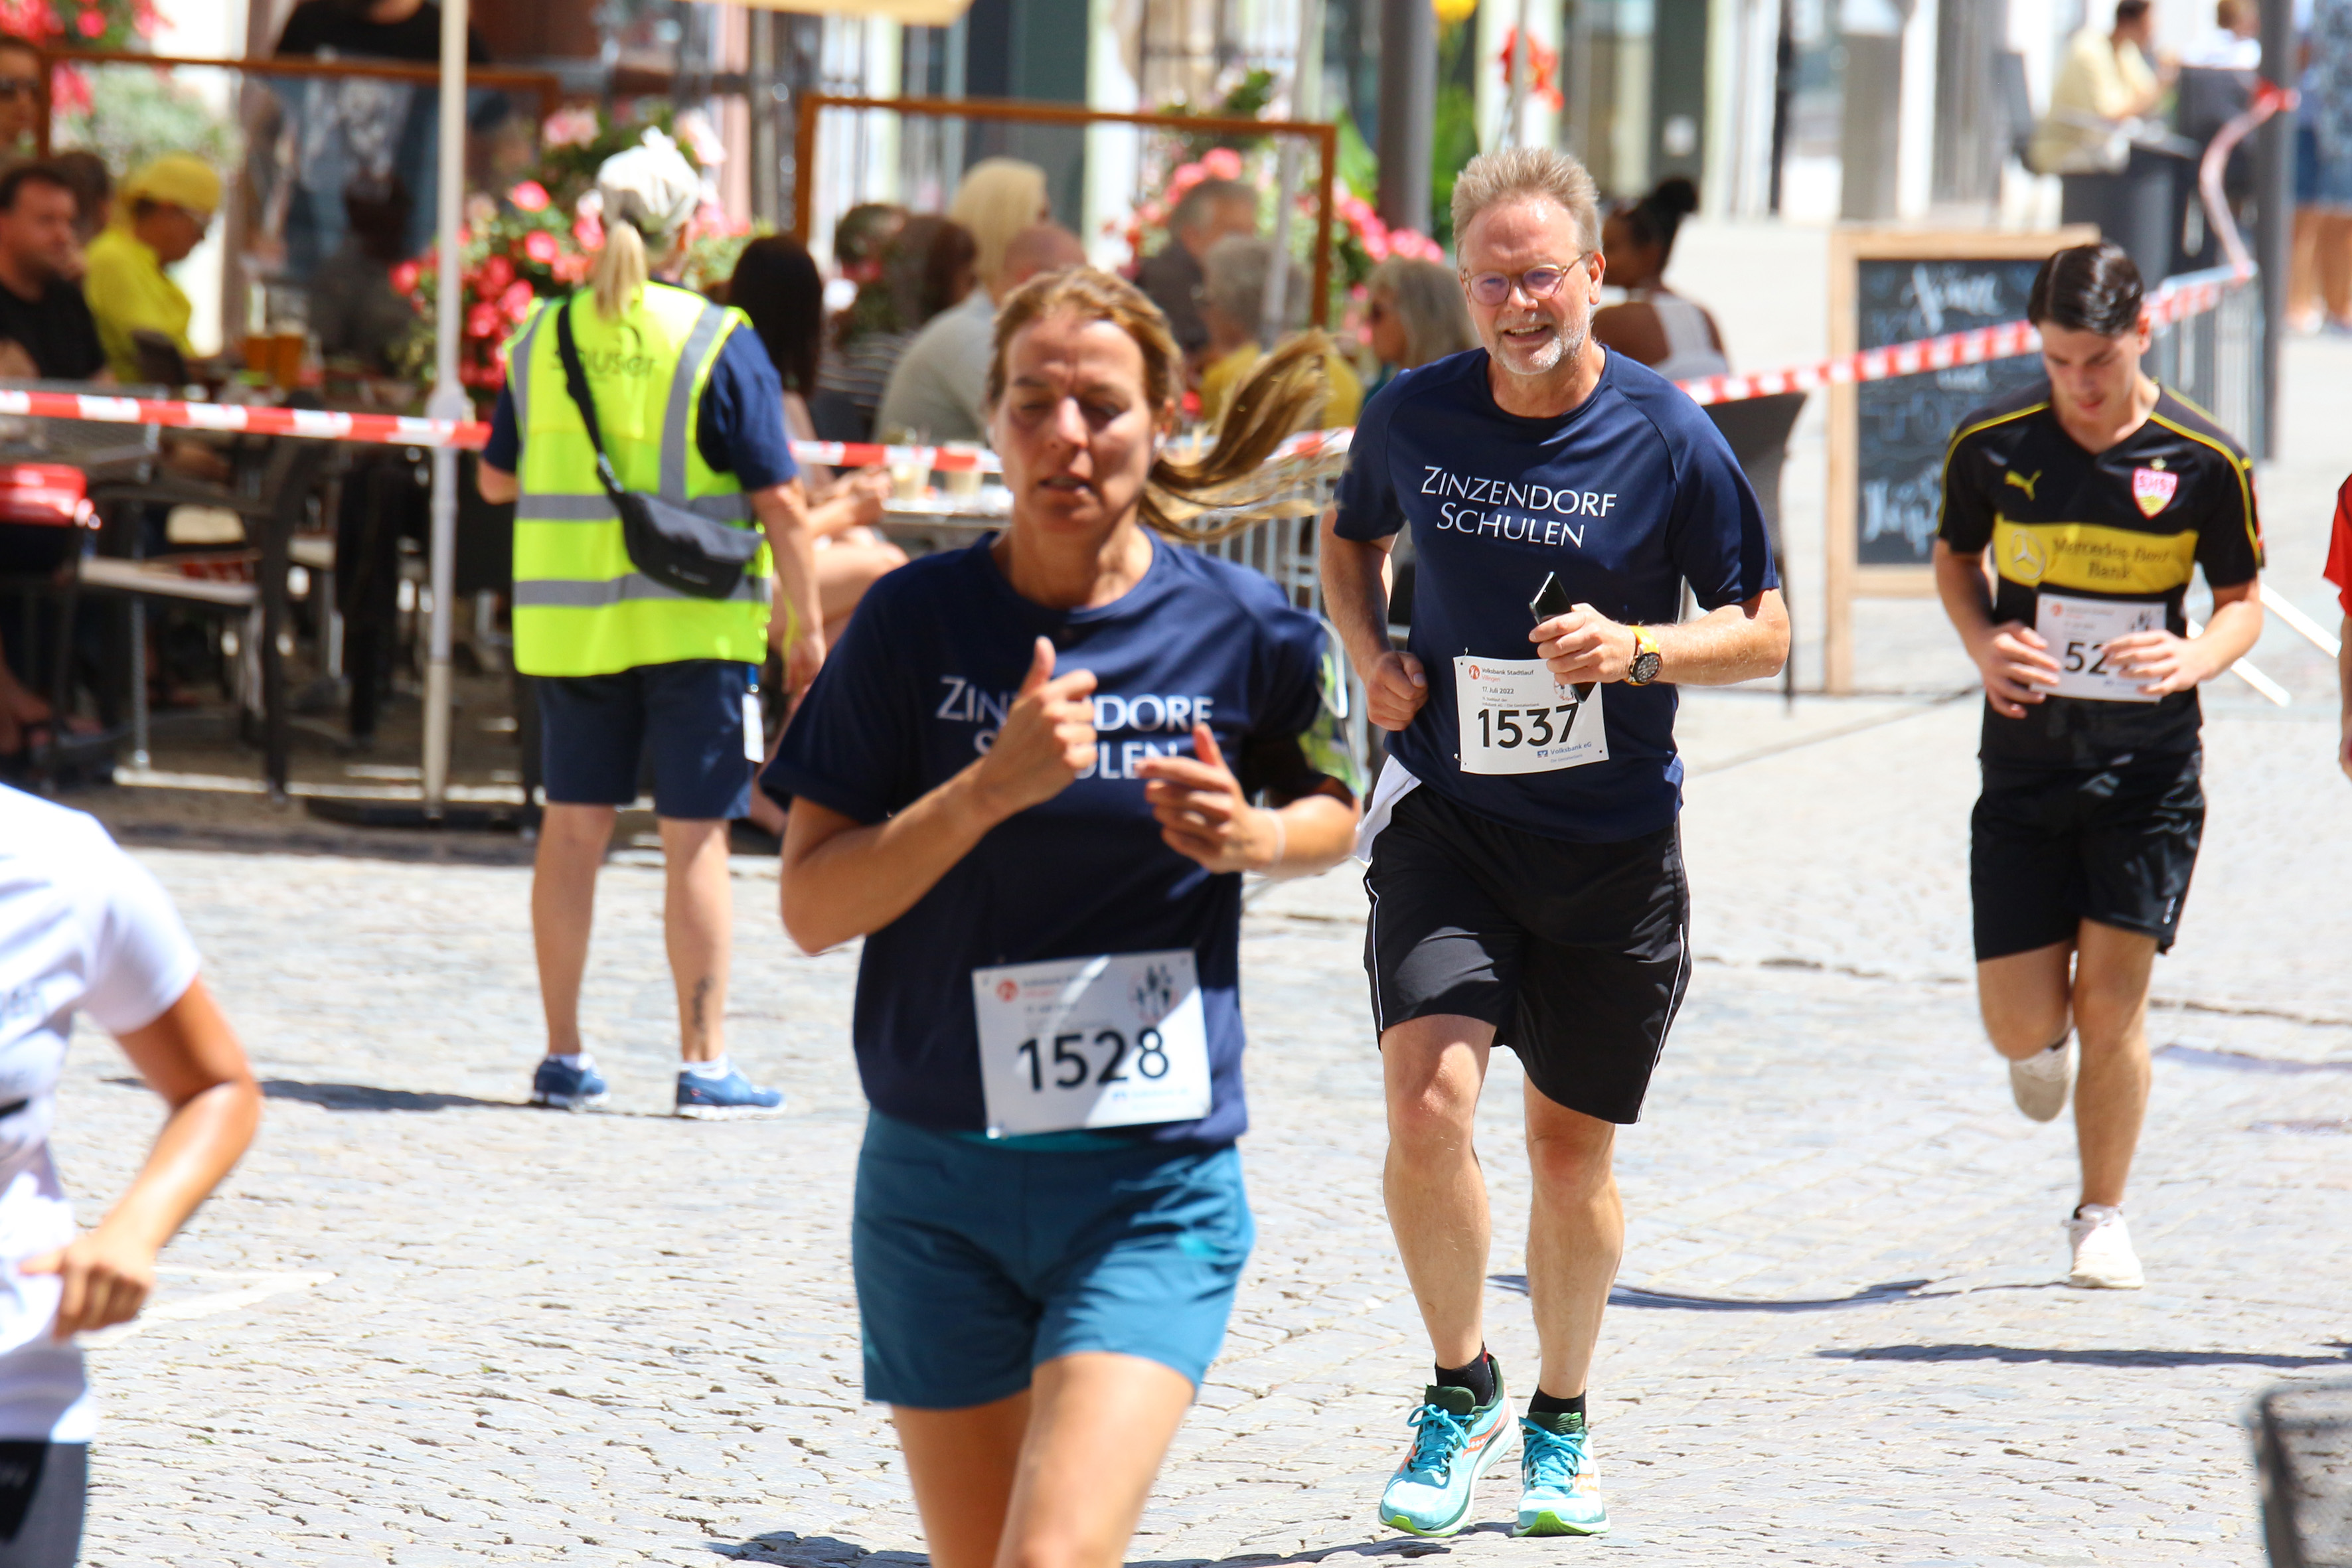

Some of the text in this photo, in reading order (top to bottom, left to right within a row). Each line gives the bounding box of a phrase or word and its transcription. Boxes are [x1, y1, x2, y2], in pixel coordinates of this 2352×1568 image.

[1421, 465, 1617, 517] ZINZENDORF
[1436, 502, 1585, 548] SCHULEN
[936, 676, 1214, 732] ZINDORF
[1478, 702, 1579, 748] 1537
[1550, 744, 1581, 755] Volksbank
[1018, 1027, 1169, 1093] 1528
